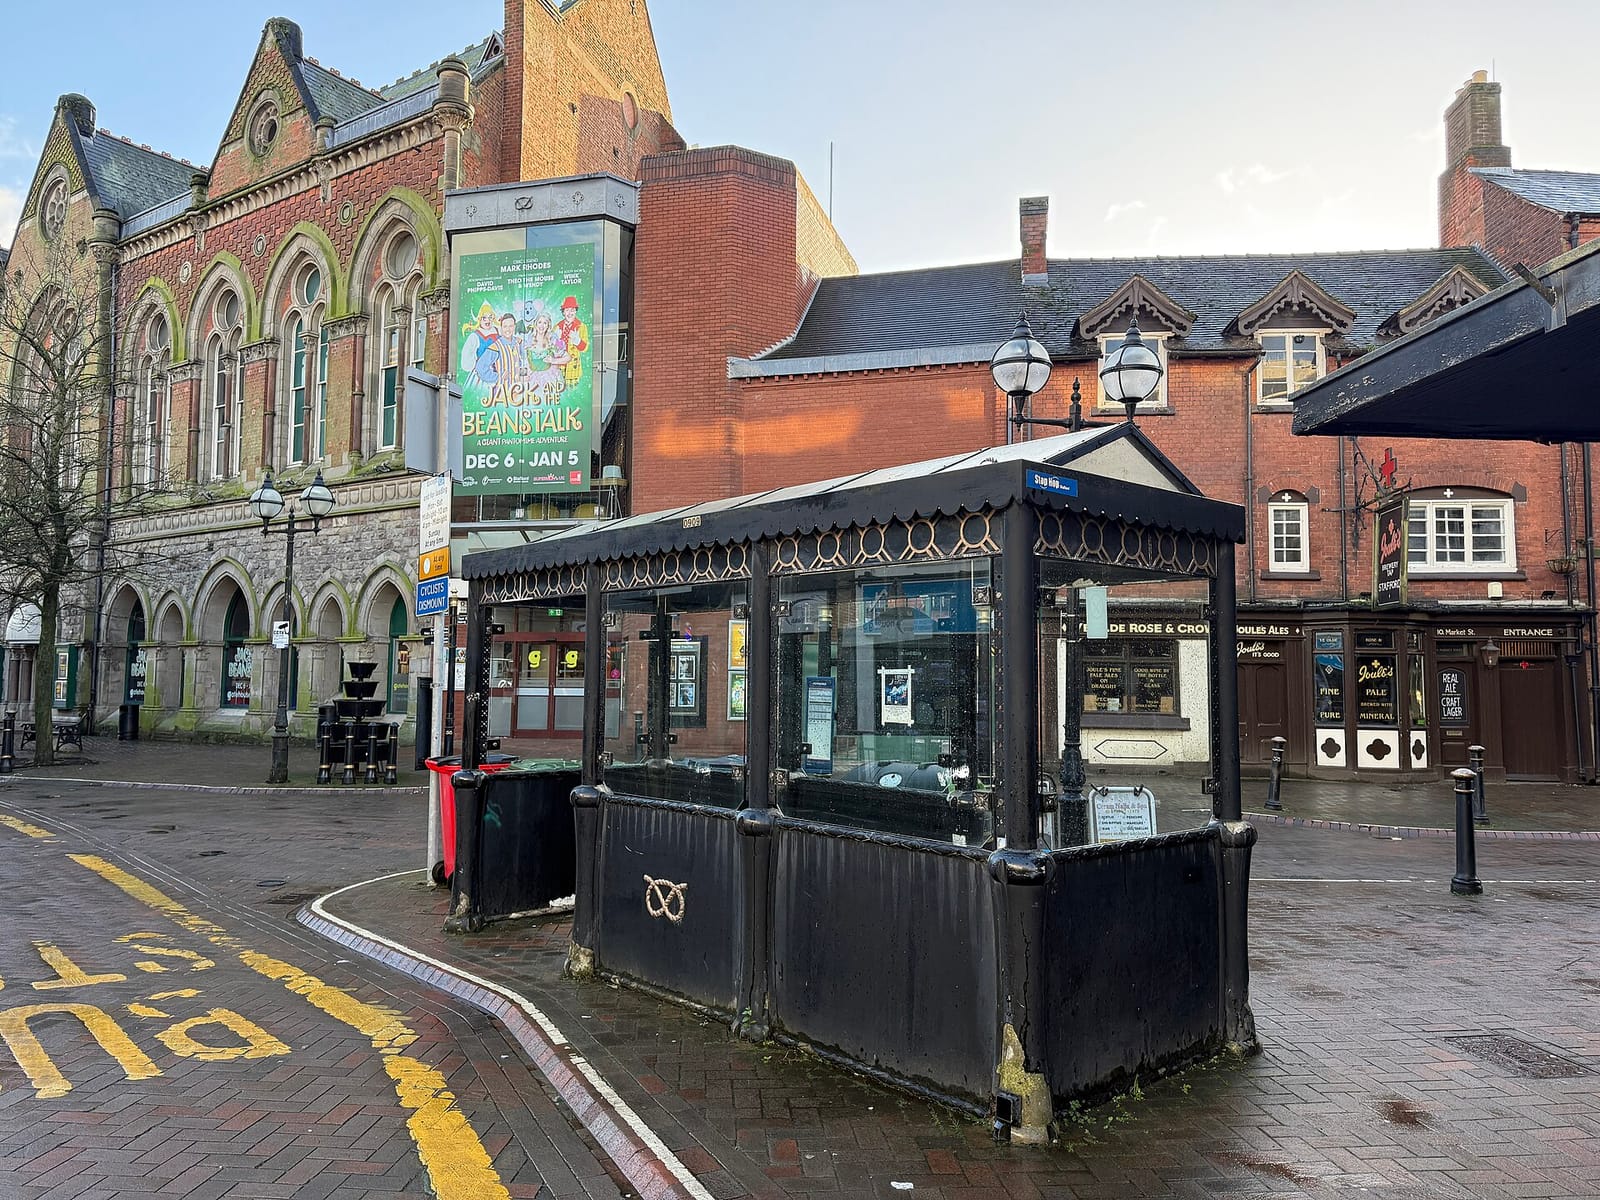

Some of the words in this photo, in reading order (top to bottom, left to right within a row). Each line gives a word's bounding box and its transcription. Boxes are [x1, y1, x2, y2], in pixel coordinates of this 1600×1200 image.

[500, 265, 520, 273] MARK
[522, 262, 551, 271] RHODES
[482, 384, 541, 408] JACK
[543, 381, 566, 393] AND
[544, 393, 561, 405] THE
[463, 407, 583, 436] BEANSTALK
[466, 453, 499, 469] DEC
[504, 453, 514, 468] 6
[529, 451, 562, 467] JAN
[568, 450, 579, 465] 5
[420, 582, 444, 596] CYCLISTS
[419, 597, 445, 610] DISMOUNT
[1129, 624, 1162, 633] ROSE
[1165, 624, 1175, 633] &
[1268, 626, 1289, 634] ALES
[1236, 641, 1265, 658] Joule's
[1358, 665, 1393, 683] Joule's
[1442, 673, 1458, 683] REAL
[1320, 687, 1340, 696] FINE
[1444, 683, 1457, 693] ALE
[1441, 697, 1460, 707] CRAFT
[1442, 707, 1462, 717] LAGER
